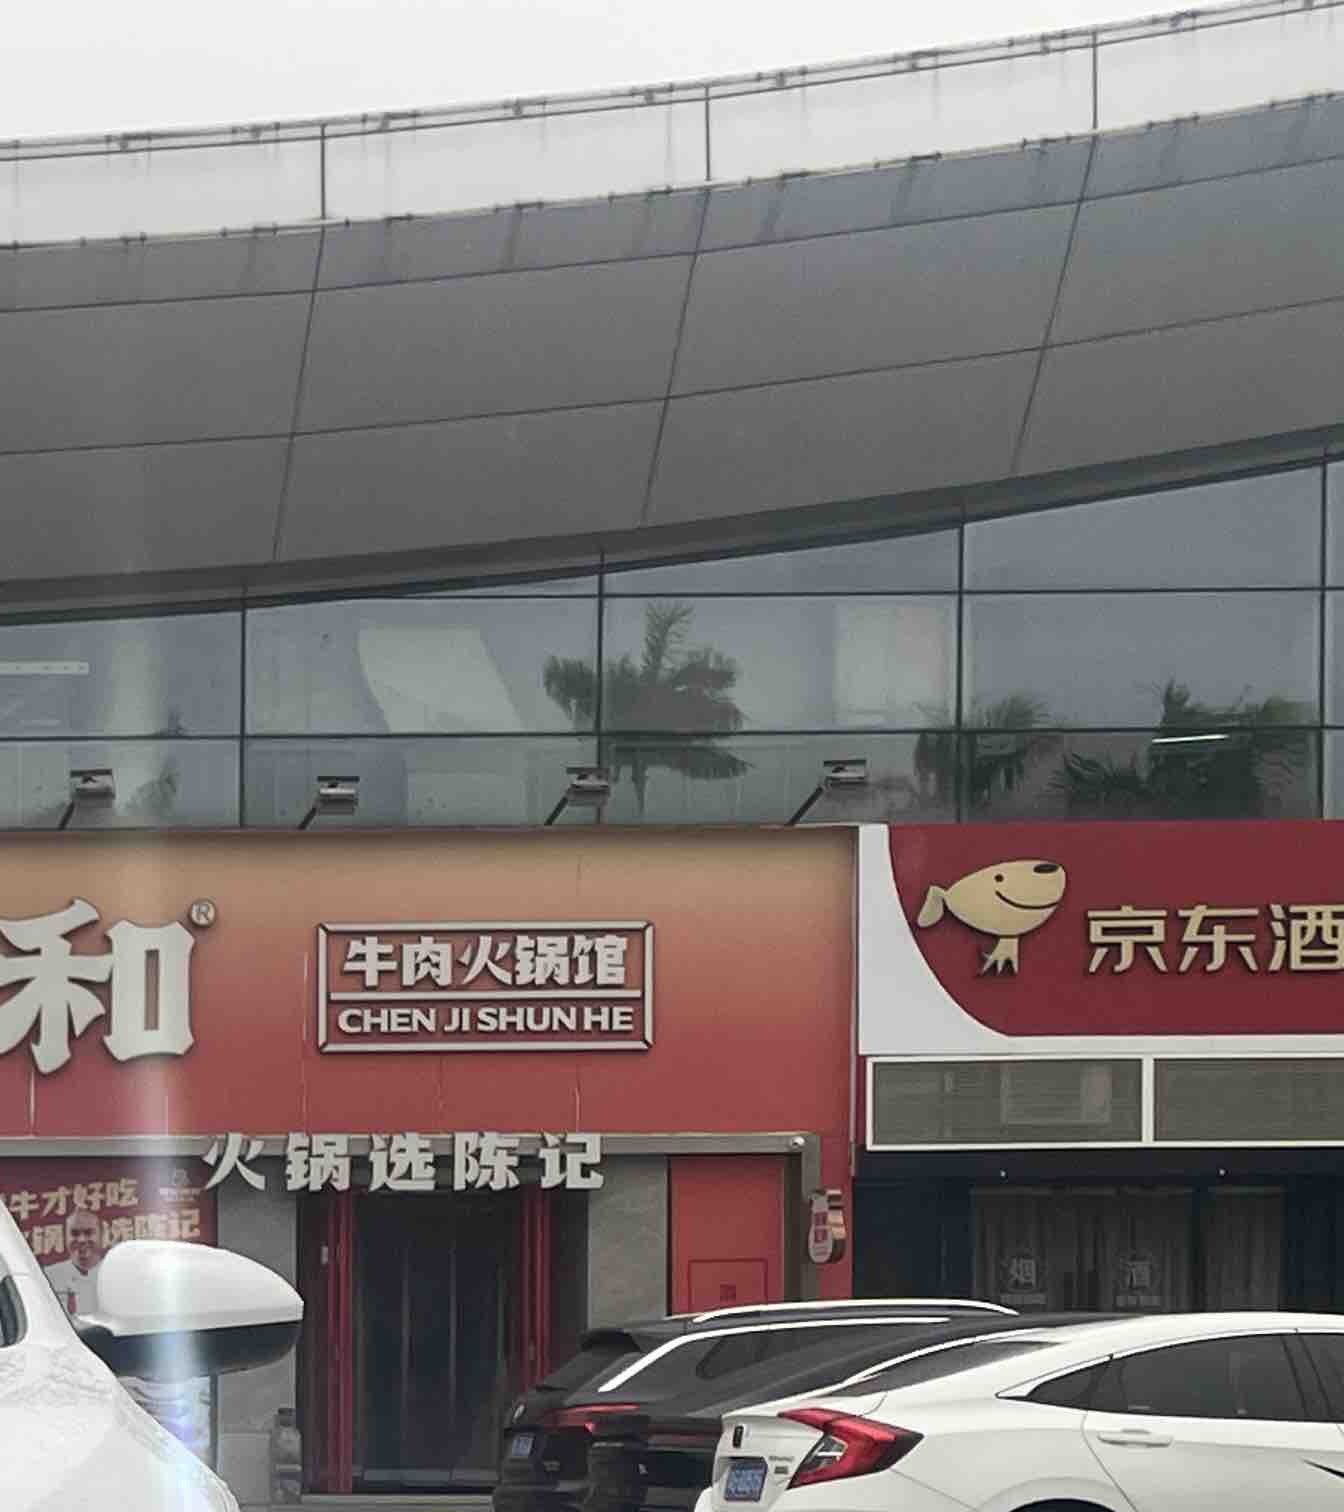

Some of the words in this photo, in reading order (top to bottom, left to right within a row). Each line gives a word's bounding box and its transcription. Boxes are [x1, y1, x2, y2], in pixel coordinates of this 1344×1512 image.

[343, 935, 628, 988] 牛肉火锅馆
[1086, 904, 1344, 974] 京东酒
[338, 1006, 436, 1034] CHEN
[443, 1007, 471, 1034] JI
[477, 1006, 578, 1033] SHUN
[583, 1006, 634, 1033] HE
[202, 1131, 606, 1193] 火锅选陈记
